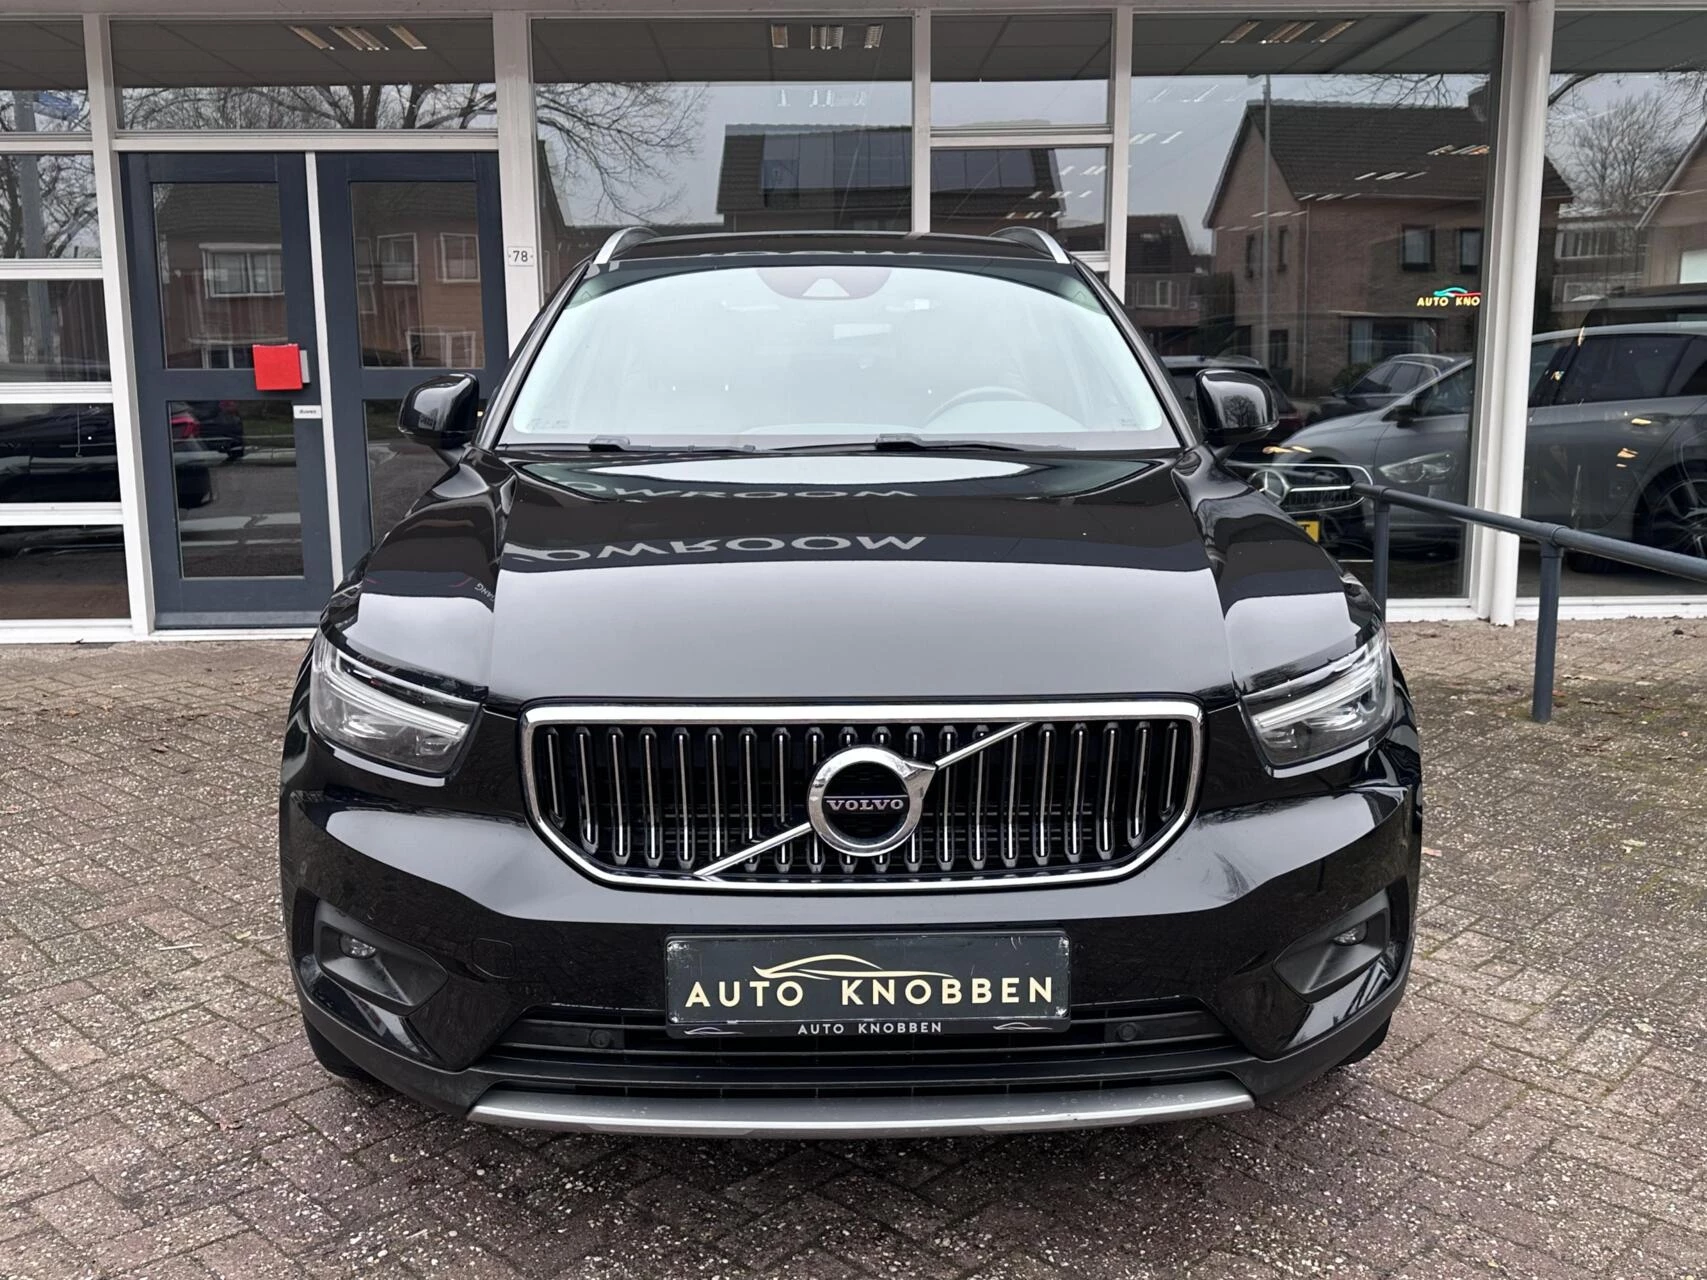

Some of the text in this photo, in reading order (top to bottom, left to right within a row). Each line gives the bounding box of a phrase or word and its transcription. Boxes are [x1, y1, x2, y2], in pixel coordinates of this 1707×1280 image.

[512, 250, 529, 262] 78
[1416, 296, 1481, 307] AUTO KNO
[545, 475, 919, 499] OWROOM
[826, 799, 904, 811] VOLVO
[685, 976, 1053, 1008] AUTO KNOBBEN
[797, 1021, 942, 1036] AUTO KNOBBEN
